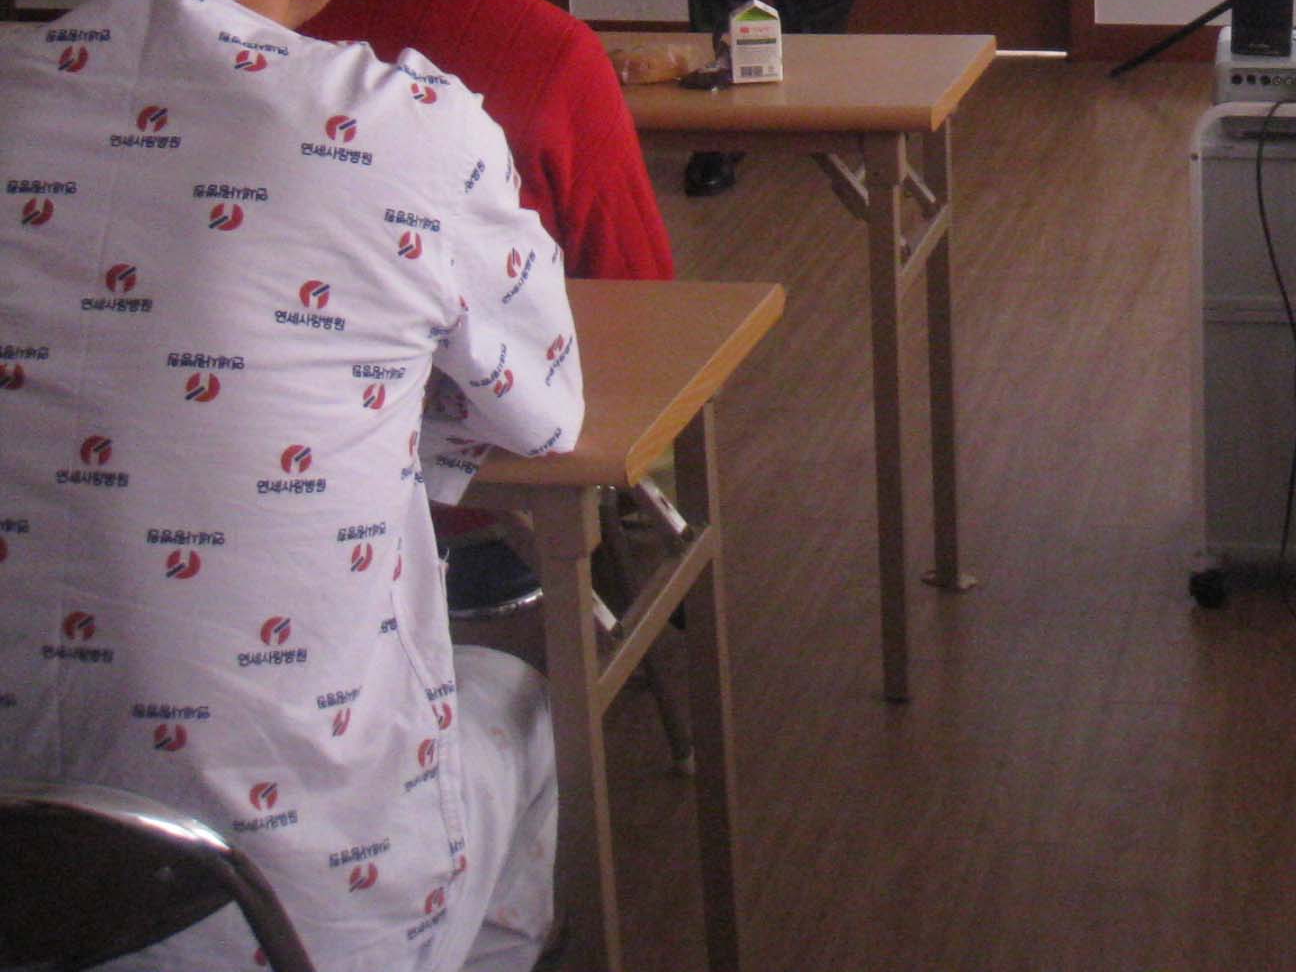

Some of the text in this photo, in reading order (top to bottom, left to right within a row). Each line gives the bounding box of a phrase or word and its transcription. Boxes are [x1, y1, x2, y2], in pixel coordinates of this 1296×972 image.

[300, 142, 374, 166] 연세사랑병원
[193, 183, 269, 202] 연세사랑병원
[273, 309, 346, 332] 연세사랑병원
[167, 351, 245, 371] 연세사랑병원
[256, 478, 327, 495] 연세사랑병원
[147, 529, 225, 546] 연세사랑병원
[237, 648, 308, 667] 연세사랑병원
